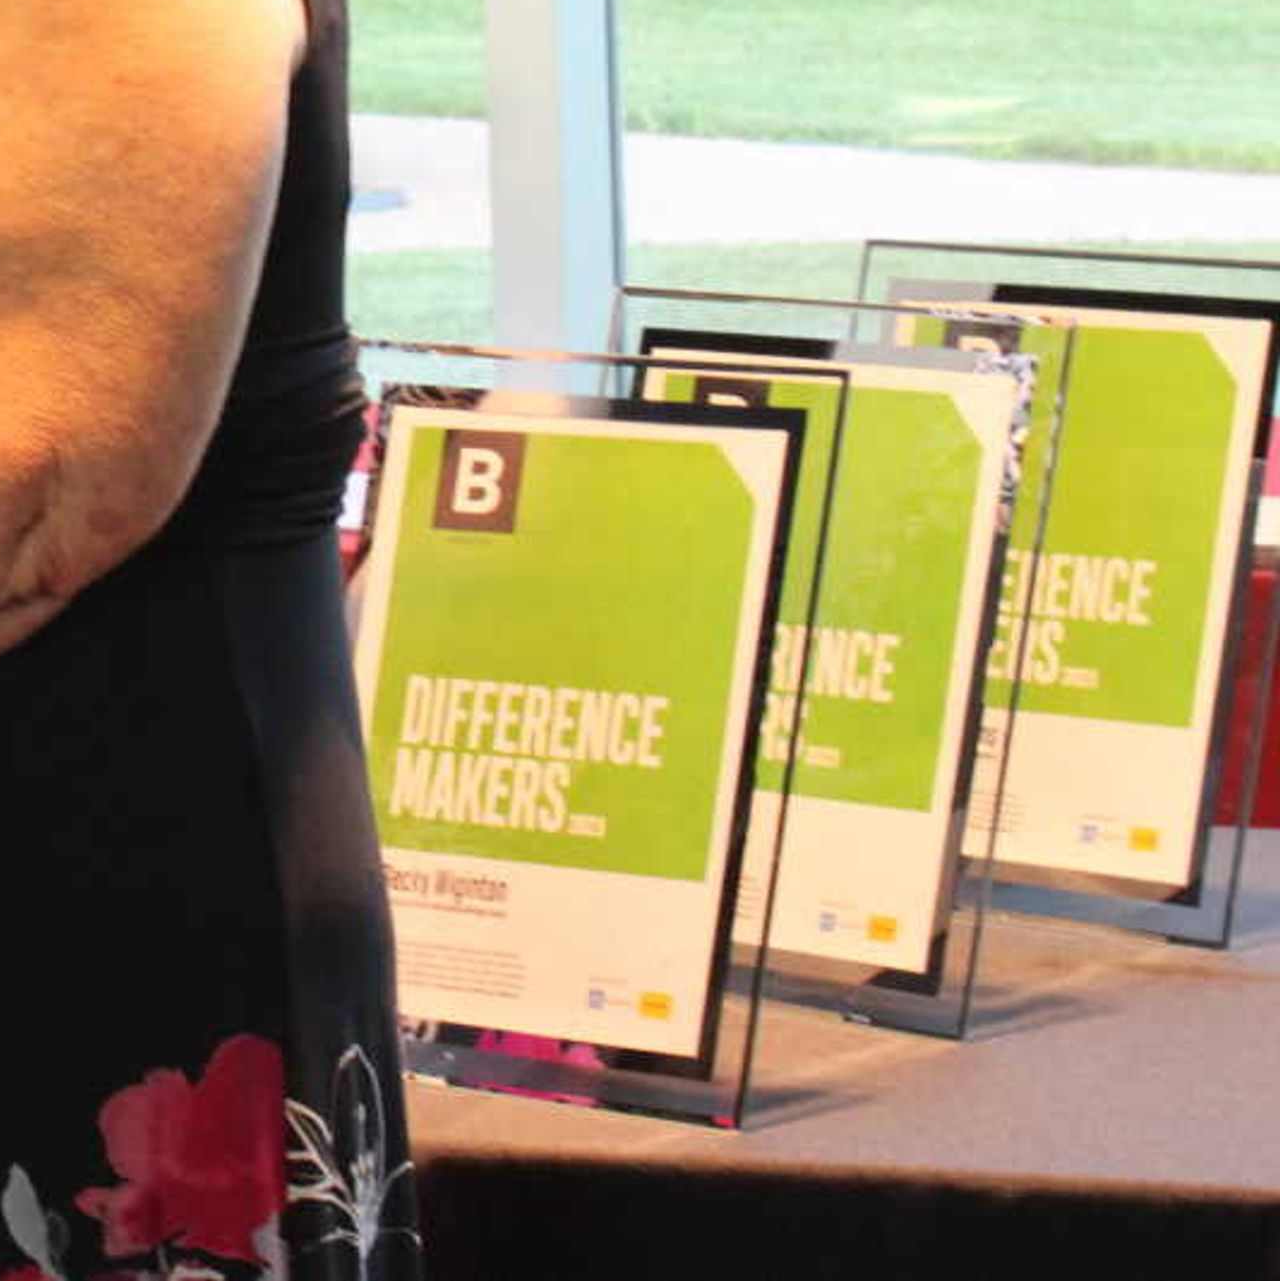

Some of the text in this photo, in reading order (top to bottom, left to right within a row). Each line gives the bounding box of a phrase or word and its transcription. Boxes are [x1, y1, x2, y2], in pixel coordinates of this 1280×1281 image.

[450, 447, 505, 516] B
[398, 673, 673, 770] DIFFERENCE
[387, 747, 573, 835] MAKERS
